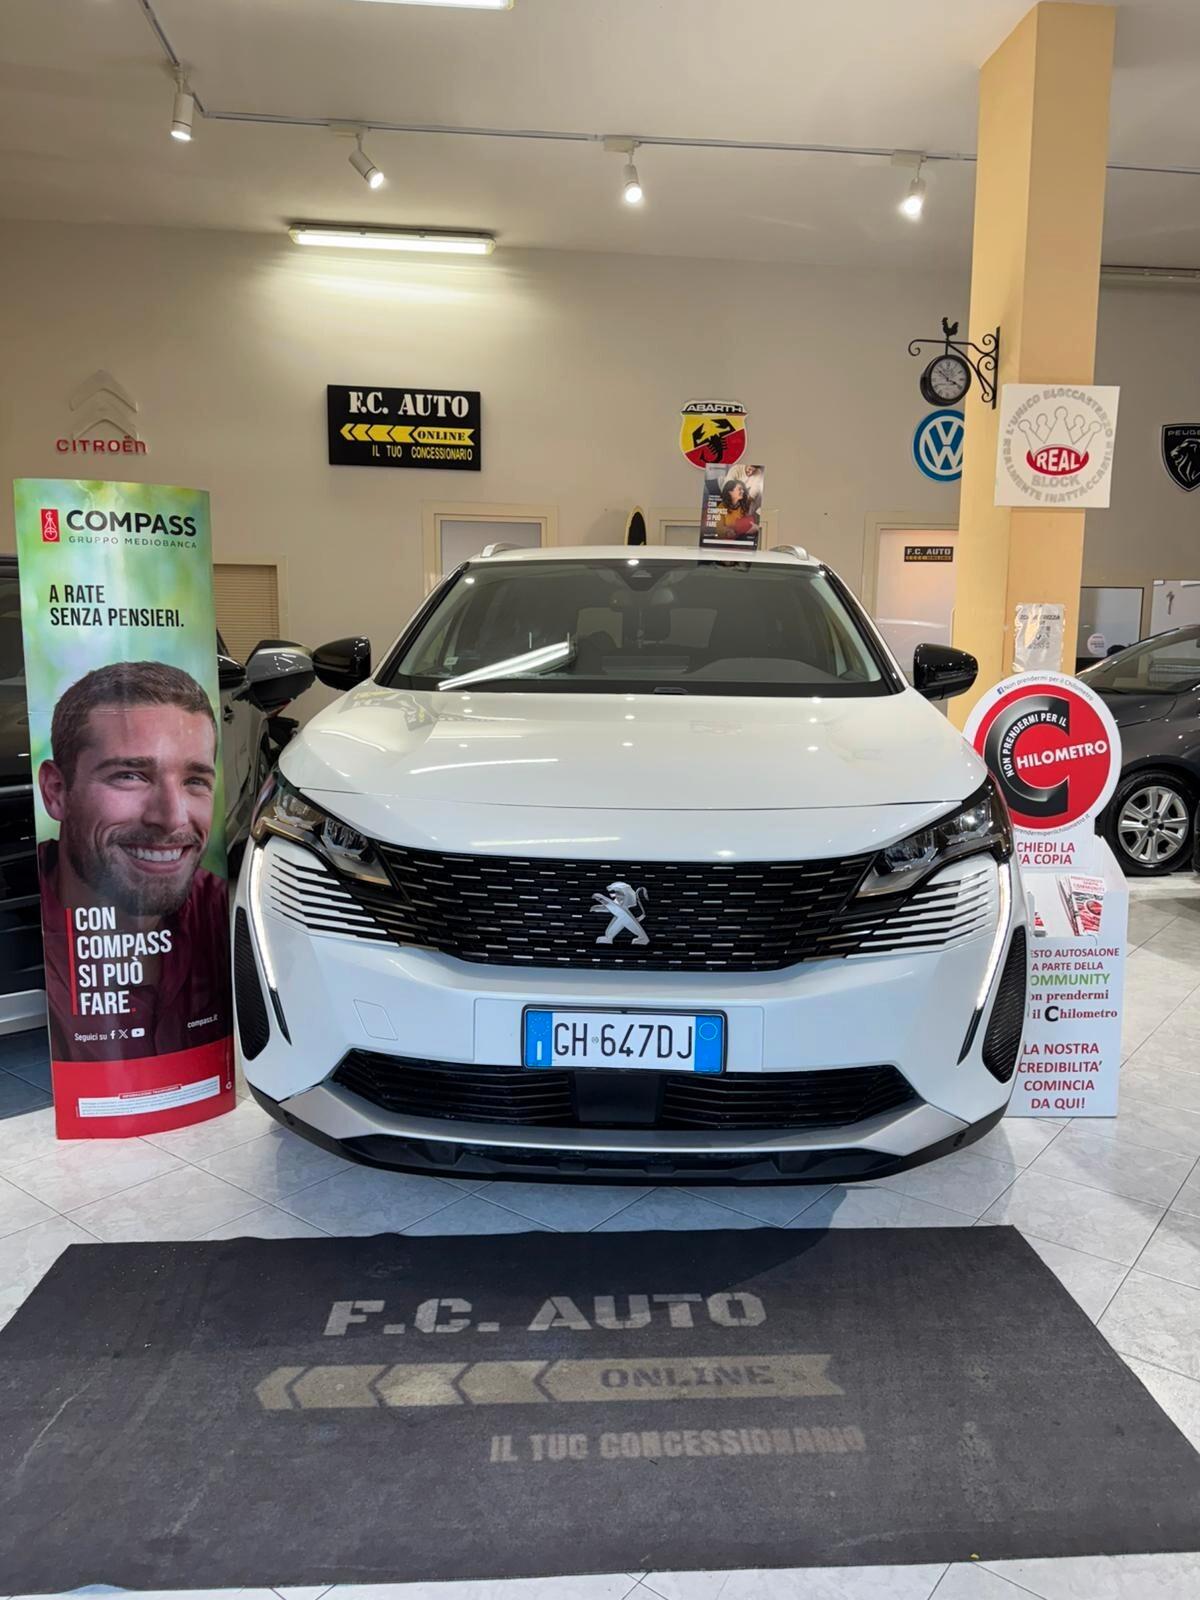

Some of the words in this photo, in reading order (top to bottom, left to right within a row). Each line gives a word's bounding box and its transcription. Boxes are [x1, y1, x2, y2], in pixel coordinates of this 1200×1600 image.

[349, 391, 389, 414] F.C.
[398, 394, 469, 418] AUTO
[686, 403, 744, 413] ABARTH
[417, 430, 466, 441] ONLINE
[372, 445, 380, 457] IL
[386, 445, 402, 458] TUO
[411, 446, 472, 461] CONCESSIONARIO
[1036, 449, 1080, 472] REAL
[1031, 474, 1080, 488] BLOCK
[66, 510, 197, 537] COMPASS
[68, 535, 119, 544] GRUPPO
[125, 538, 197, 549] MEDIOBANCA
[49, 584, 60, 603] A
[65, 584, 105, 603] RATE
[51, 607, 102, 626] SENZA
[108, 608, 184, 627] PENSIERI.
[1041, 713, 1058, 722] PER
[1059, 716, 1067, 727] IL
[1002, 713, 1039, 754] PRENDERMI
[1003, 758, 1015, 777] NON
[1061, 842, 1075, 853] LA
[1034, 854, 1072, 865] COPIA
[75, 906, 116, 931] CON
[77, 929, 173, 960] COMPASS
[1054, 948, 1119, 958] AUTOSALONE
[79, 965, 97, 988] SI
[104, 956, 143, 986] PUÒ
[1032, 963, 1039, 971] A
[1042, 962, 1071, 971] PARTE
[1074, 961, 1104, 970] DELLA
[1031, 973, 1111, 986] OMMUNITY
[1031, 993, 1042, 1001] on
[1046, 989, 1109, 1003] prendermi
[187, 1013, 218, 1029] compass.it
[1032, 1009, 1040, 1019] il
[1044, 1005, 1118, 1022] Chilometro
[74, 1032, 98, 1043] Seguici
[554, 1022, 588, 1056] GH
[600, 1023, 693, 1059] 647DJ
[1024, 1043, 1039, 1055] LA
[1044, 1043, 1099, 1055] NOSTRA
[1024, 1080, 1095, 1091] COMINCIA
[1031, 1098, 1050, 1109] DA
[1054, 1097, 1085, 1110] QUI!
[323, 1298, 499, 1336] F.C.
[527, 1292, 767, 1332] AUTO
[600, 1365, 775, 1389] ONLINE
[490, 1434, 518, 1463] IL
